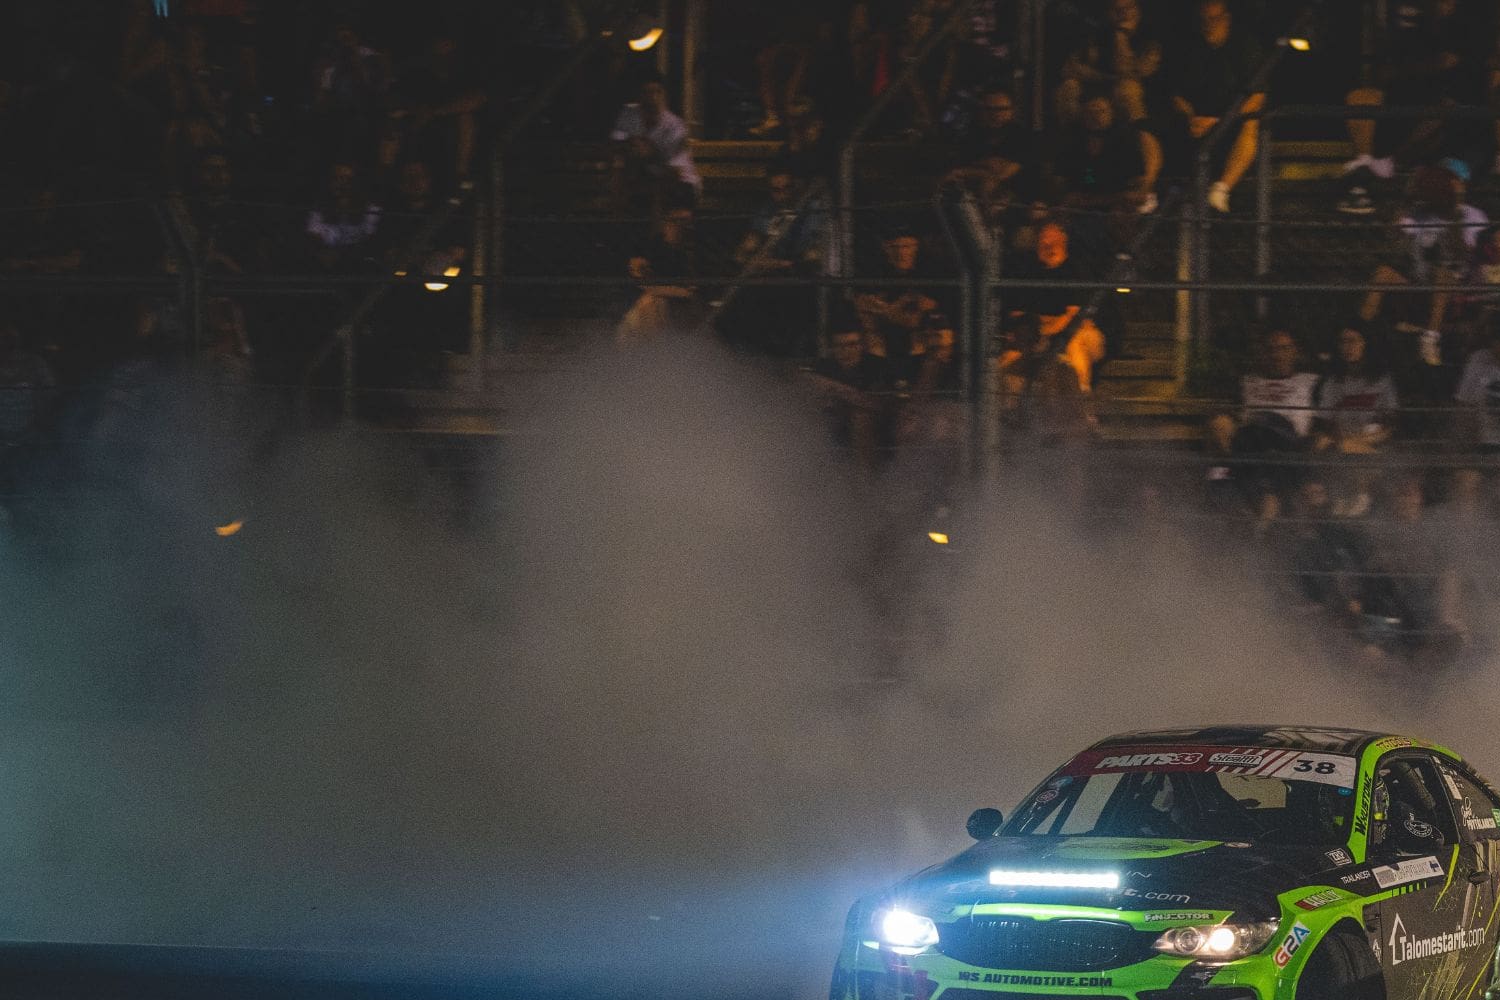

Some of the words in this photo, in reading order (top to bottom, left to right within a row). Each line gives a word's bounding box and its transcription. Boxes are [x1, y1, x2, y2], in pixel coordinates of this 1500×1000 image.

[1095, 752, 1203, 769] PARTS33
[1293, 759, 1336, 775] 38
[1275, 926, 1310, 967] G2A
[1399, 924, 1485, 961] Talomestarit.com
[983, 973, 1113, 987] AUTOMOTIVE.COM
